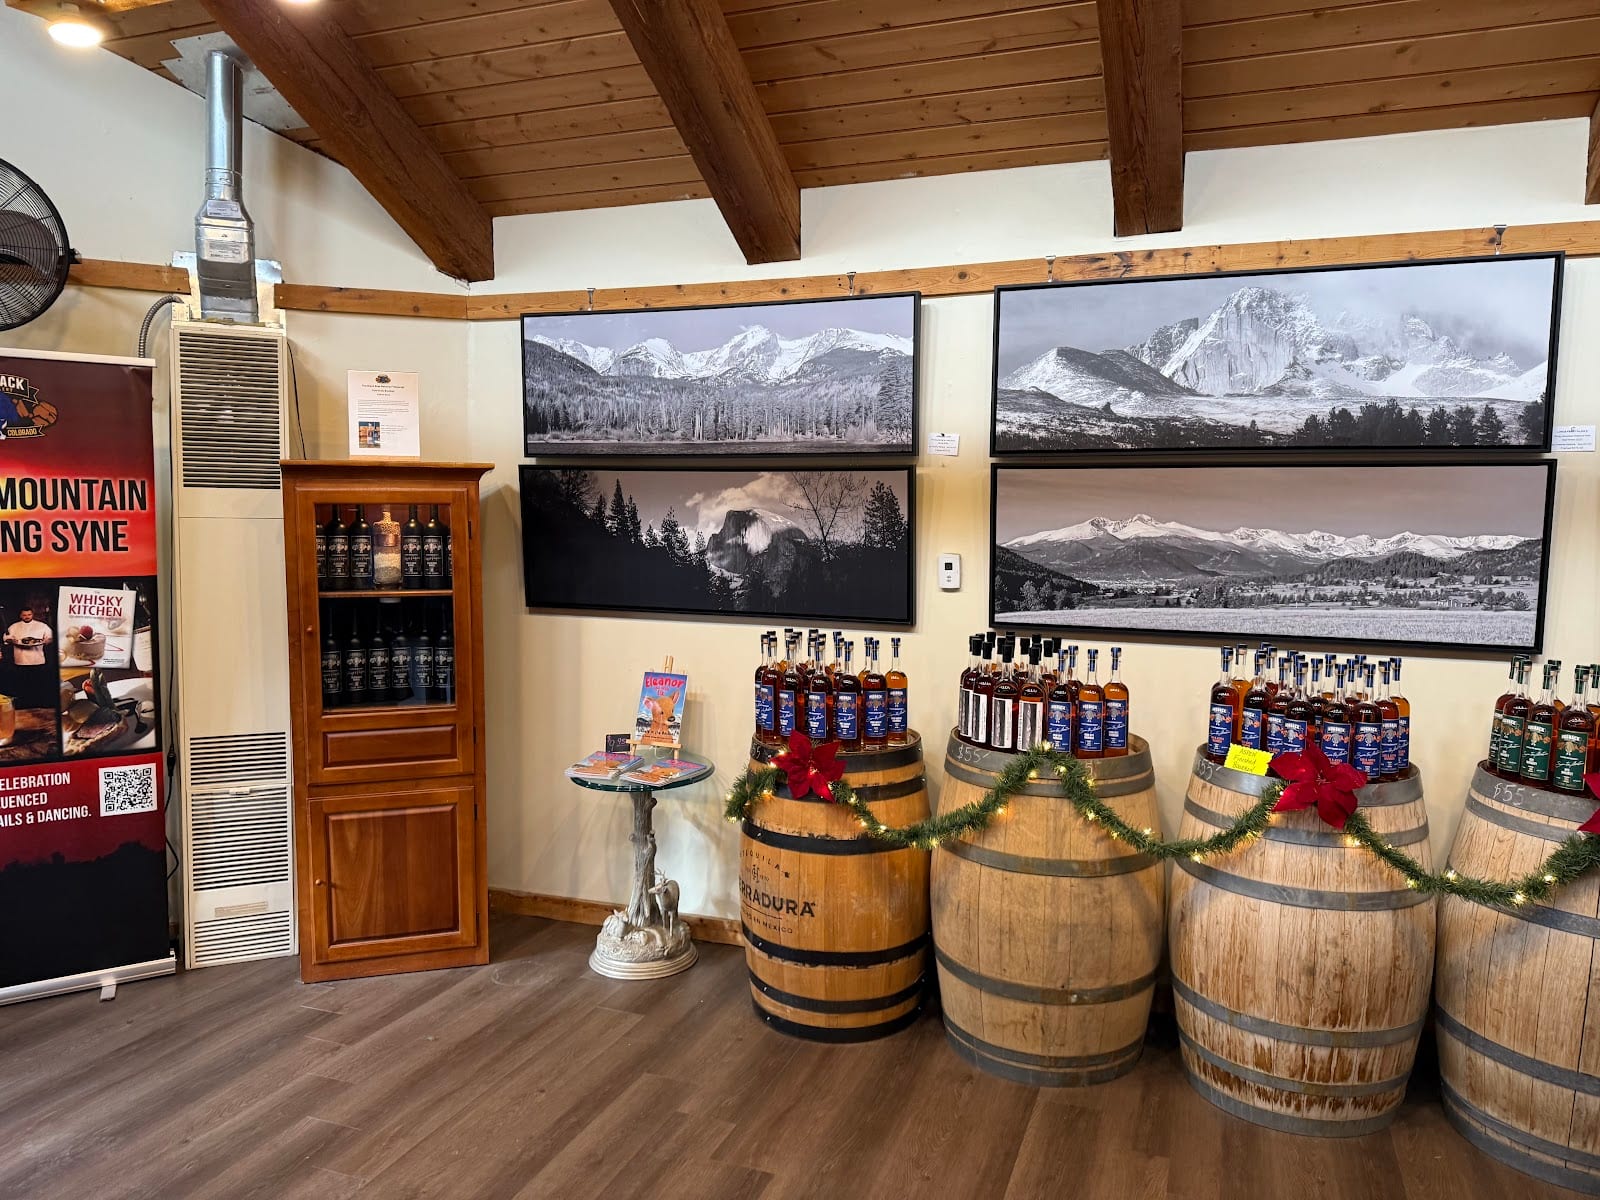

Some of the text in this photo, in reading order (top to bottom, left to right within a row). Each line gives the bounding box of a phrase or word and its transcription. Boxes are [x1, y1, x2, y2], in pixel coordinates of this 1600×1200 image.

[7, 428, 37, 437] COLORADO
[0, 477, 147, 511] MOUNTAIN
[51, 519, 129, 553] SYNE
[70, 593, 124, 606] WHISKY
[68, 604, 122, 617] KITCHEN
[645, 675, 687, 688] Eleanor
[25, 811, 35, 824] &
[36, 805, 92, 823] DANCING.
